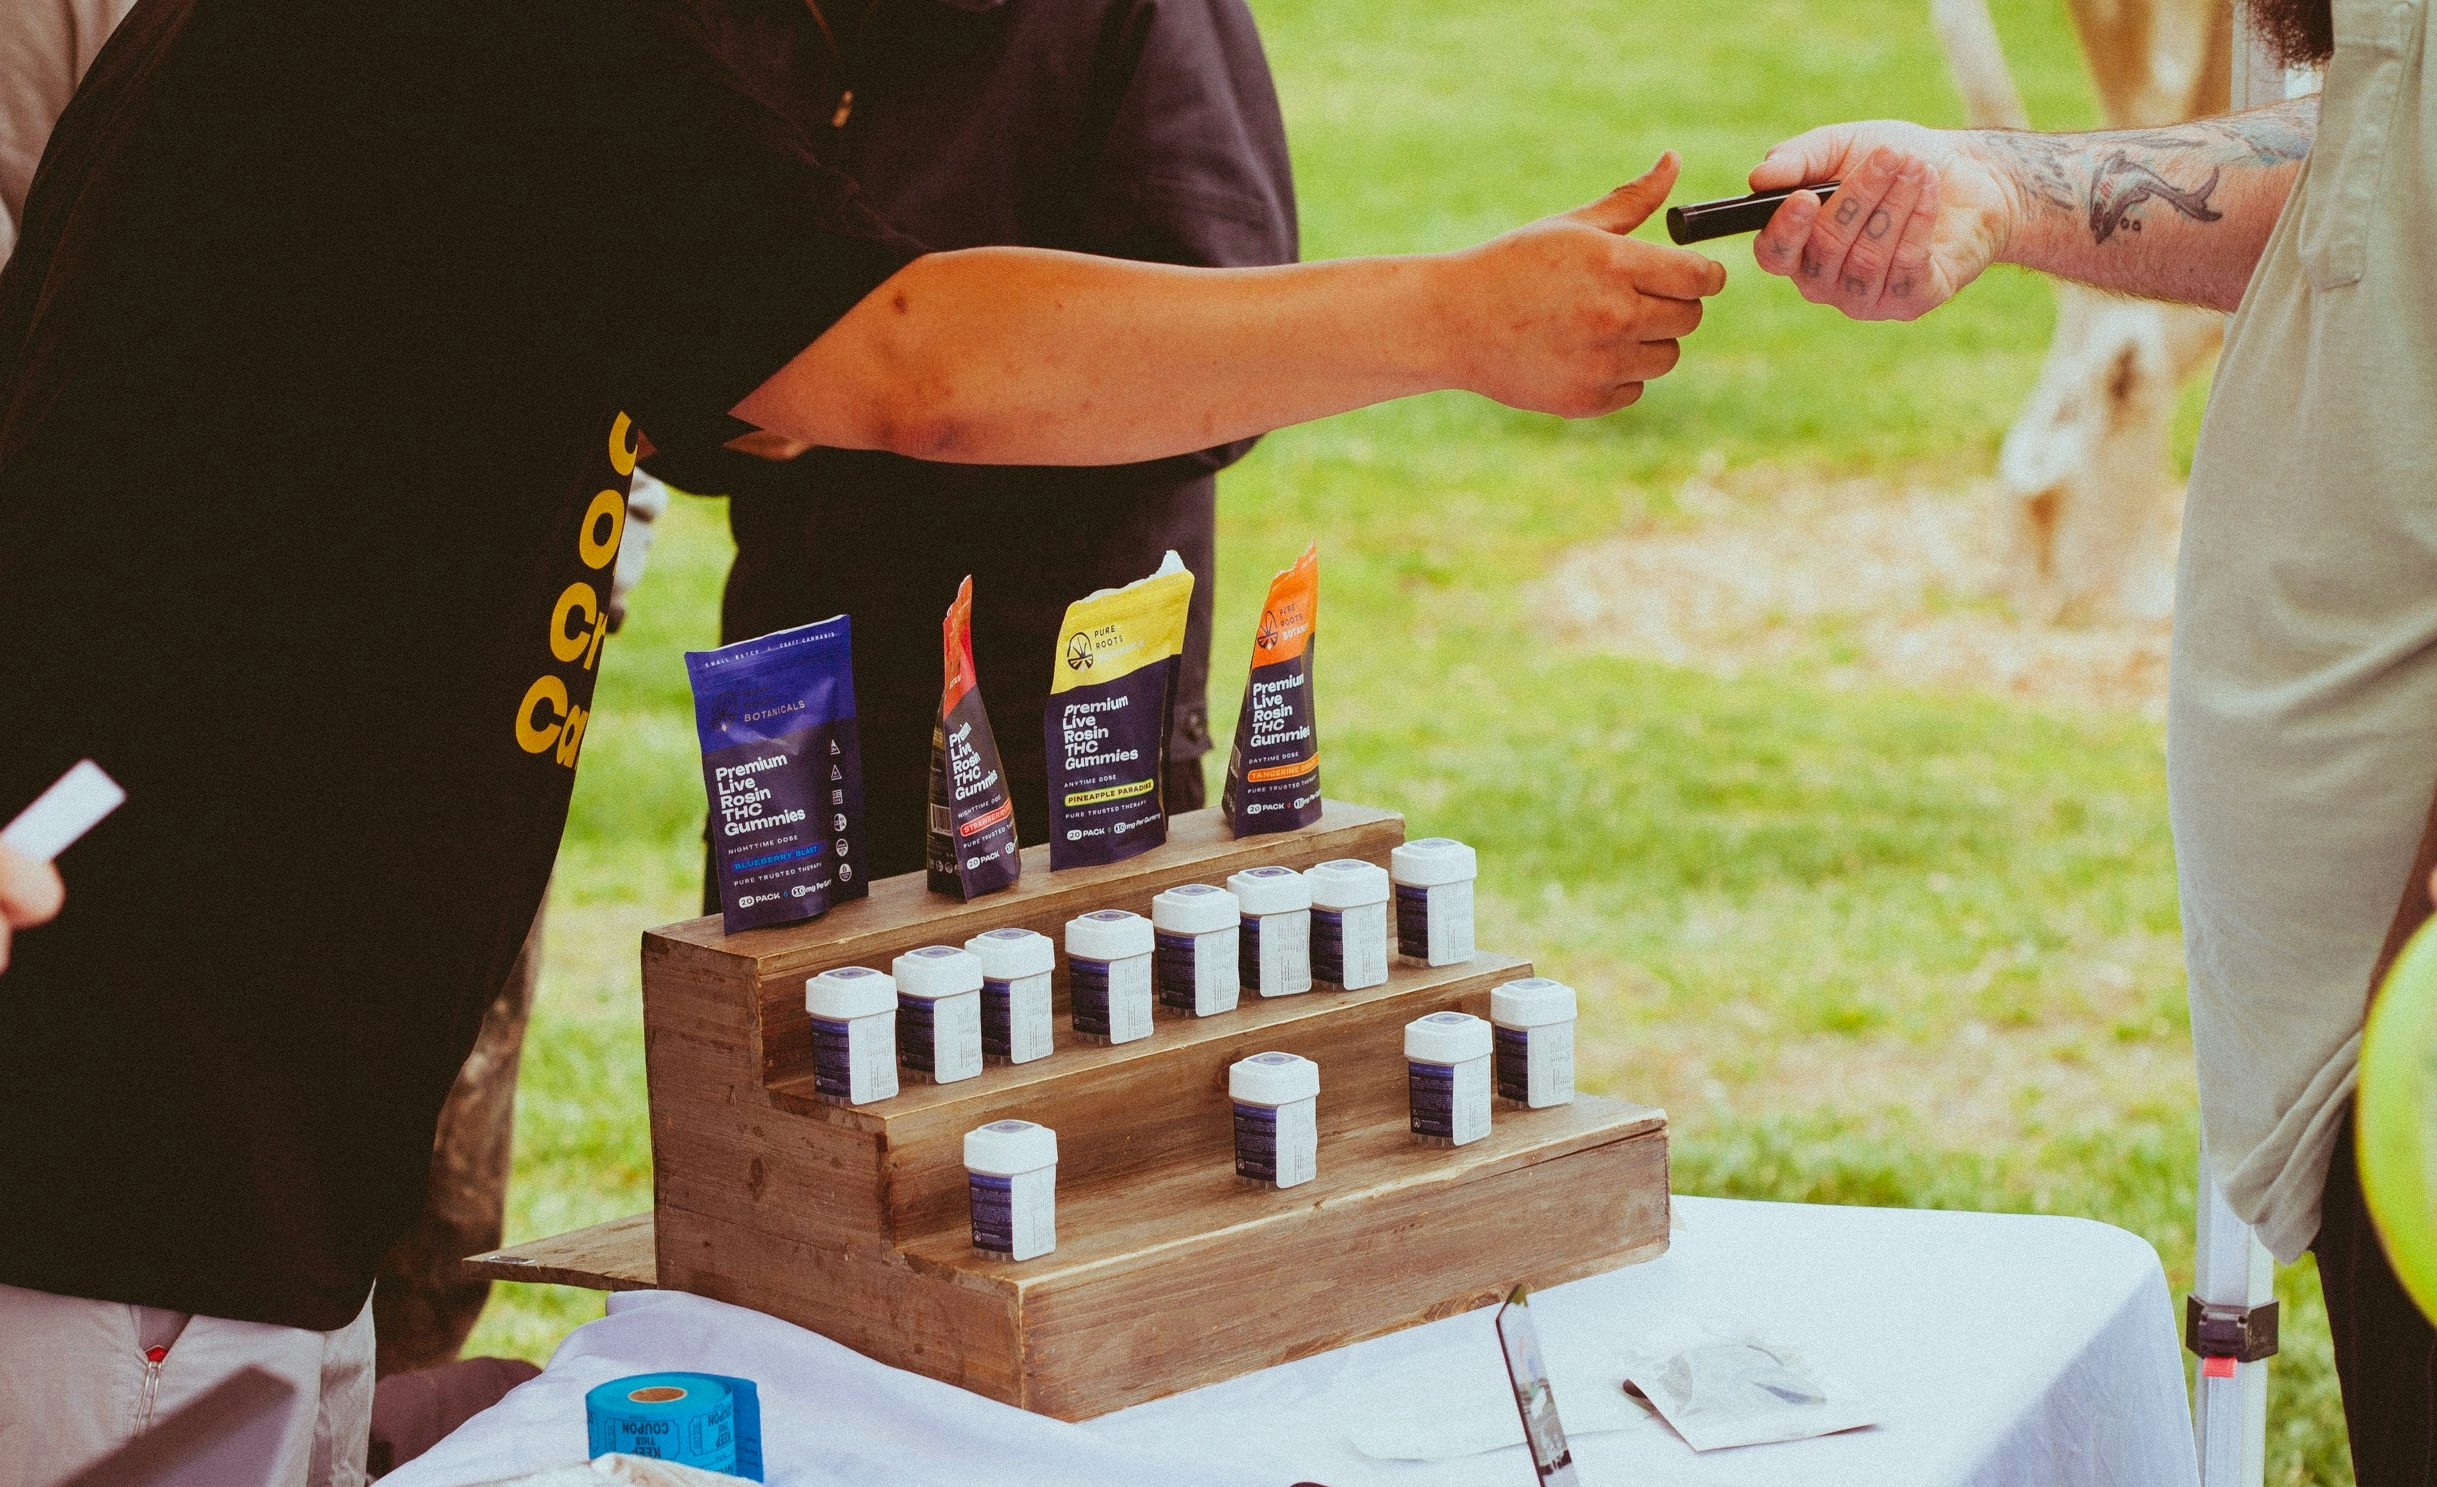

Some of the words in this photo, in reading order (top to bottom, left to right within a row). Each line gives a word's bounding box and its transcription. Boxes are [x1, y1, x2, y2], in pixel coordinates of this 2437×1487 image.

[1094, 625, 1116, 638] PURE
[1096, 635, 1124, 650] ROOTS
[744, 700, 806, 722] BOTANICALS
[1063, 695, 1129, 717] Premium
[1253, 694, 1283, 710] Live
[515, 674, 588, 770] Ca
[1062, 714, 1096, 730] Live
[1253, 704, 1293, 722] Rosin
[1064, 725, 1109, 744] Rosin
[1252, 719, 1285, 735] THC
[1065, 740, 1098, 757] THC
[1065, 749, 1139, 771] Gummies
[1249, 755, 1279, 765] DAYTIME
[1282, 751, 1299, 759] DOSE
[715, 754, 788, 781] Premium
[954, 766, 981, 787] THC
[1252, 766, 1299, 779] TANGERINE
[718, 777, 755, 795] Live
[1063, 778, 1096, 788] ANYTIME
[1099, 774, 1117, 782] DOSE
[1269, 782, 1300, 791] TRUSTED
[720, 787, 771, 809] Rosin
[1068, 790, 1116, 804] PINEAPPLE
[1118, 782, 1152, 795] PARADISE
[721, 802, 763, 822] THC
[958, 801, 989, 819] NIGHTTIME
[1088, 806, 1119, 816] TRUSTED
[1121, 800, 1147, 810] THERAPY
[1262, 803, 1285, 811] PACK
[724, 809, 806, 836] Gummies
[963, 839, 980, 849] PURE
[982, 827, 1006, 841] TRUSTED
[1083, 828, 1105, 837] PACK
[728, 840, 775, 855] NIGHTTIME
[777, 834, 798, 844] DOSE
[735, 851, 792, 870] BLUEBERRY
[795, 846, 818, 857] BLAST
[981, 850, 1000, 864] PACK
[734, 877, 755, 887] PURE
[758, 870, 796, 881] TRUSTED
[797, 862, 822, 873] THERAPY
[755, 892, 781, 903] PACK
[622, 1422, 669, 1434] COUPON
[635, 1436, 656, 1445] THIS
